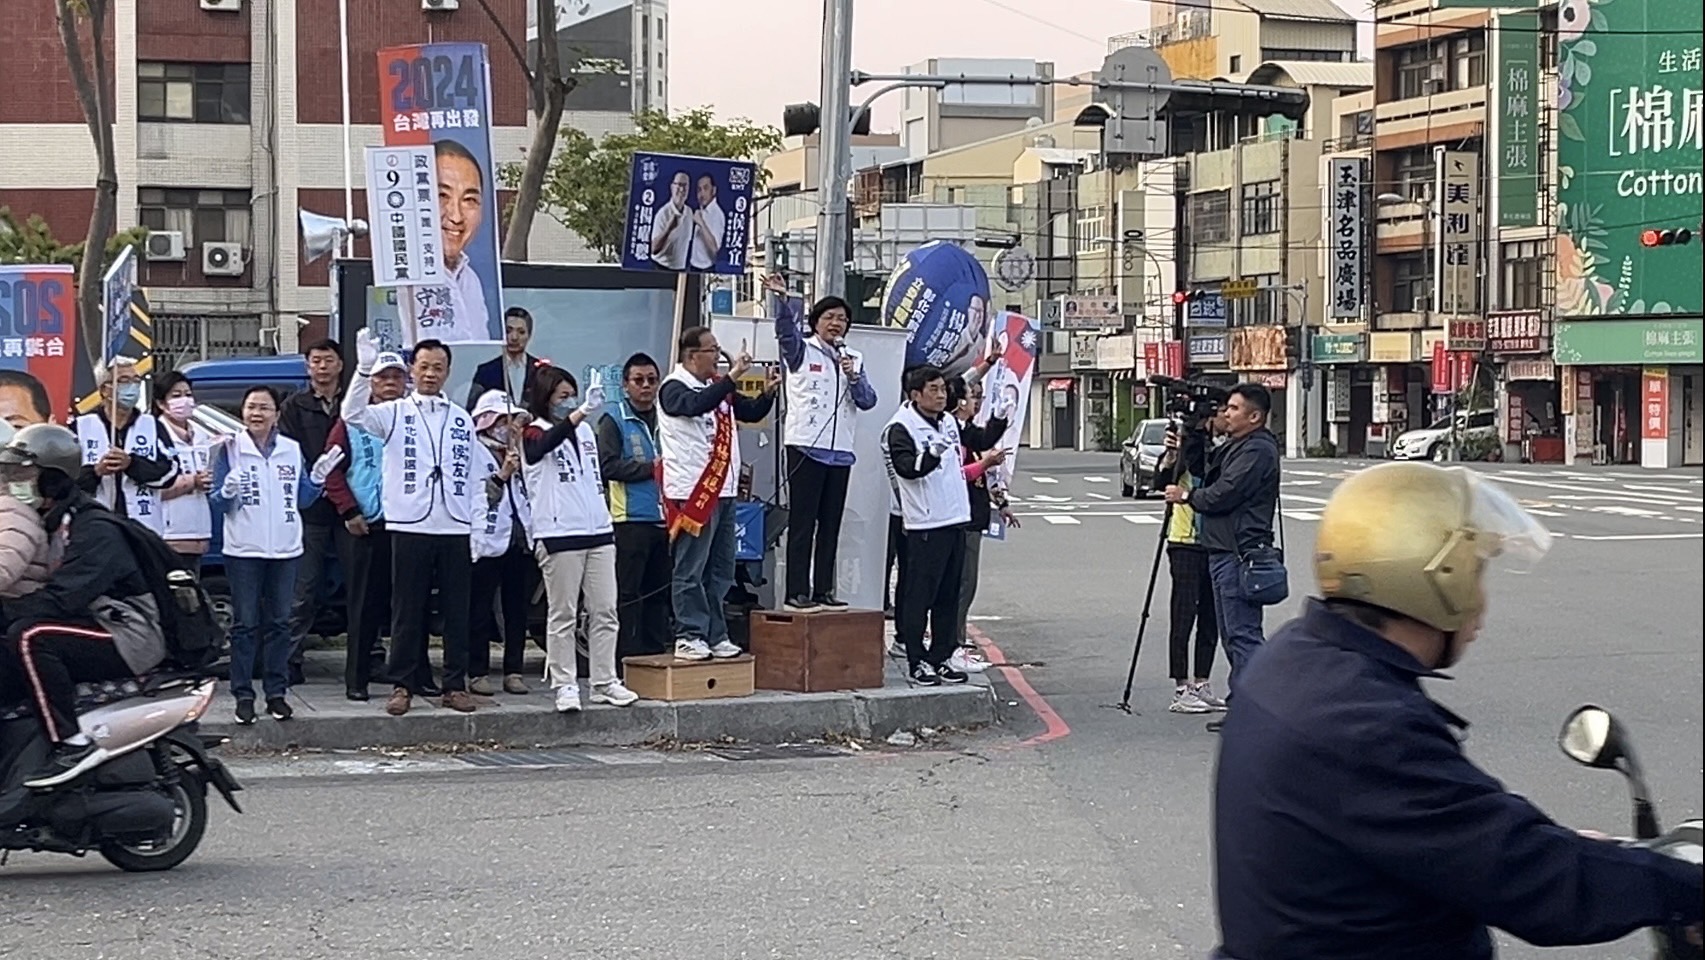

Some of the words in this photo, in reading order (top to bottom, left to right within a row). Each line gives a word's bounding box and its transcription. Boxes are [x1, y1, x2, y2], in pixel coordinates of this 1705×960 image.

[388, 55, 478, 111] 2024
[1658, 47, 1701, 73] 生活
[393, 109, 480, 132] 台灣再出發
[386, 169, 400, 189] 9
[1617, 169, 1702, 198] Cotton
[390, 212, 410, 280] 中國國民黨
[728, 212, 745, 266] 侯友宜
[1335, 165, 1358, 311] 玉津名品廣場
[1447, 183, 1470, 266] 美利達
[1648, 380, 1662, 431] 單一特價
[451, 443, 470, 497] 侯友宜
